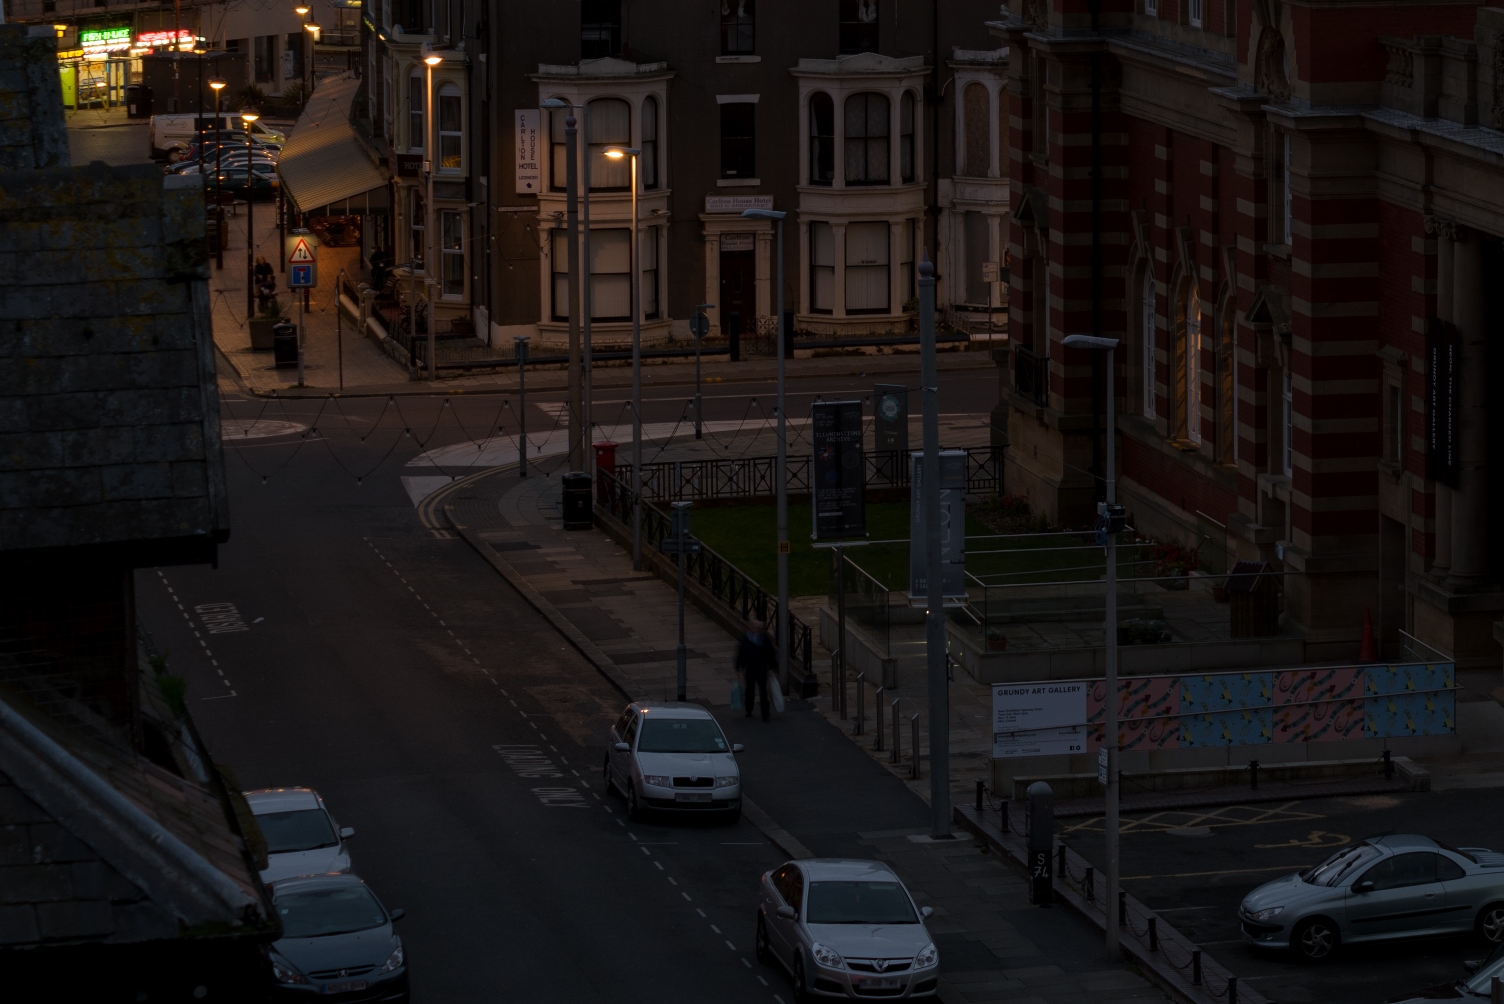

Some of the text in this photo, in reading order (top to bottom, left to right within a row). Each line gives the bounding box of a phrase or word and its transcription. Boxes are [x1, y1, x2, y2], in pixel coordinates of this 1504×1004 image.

[518, 162, 538, 170] HOTEL
[815, 430, 862, 438] ILLUMINATIONS
[780, 542, 788, 553] H
[997, 685, 1081, 697] GRUNDY ART GALLERY
[491, 744, 592, 808] LOADING ONLY
[1037, 853, 1045, 865] S
[1033, 865, 1049, 879] 74
